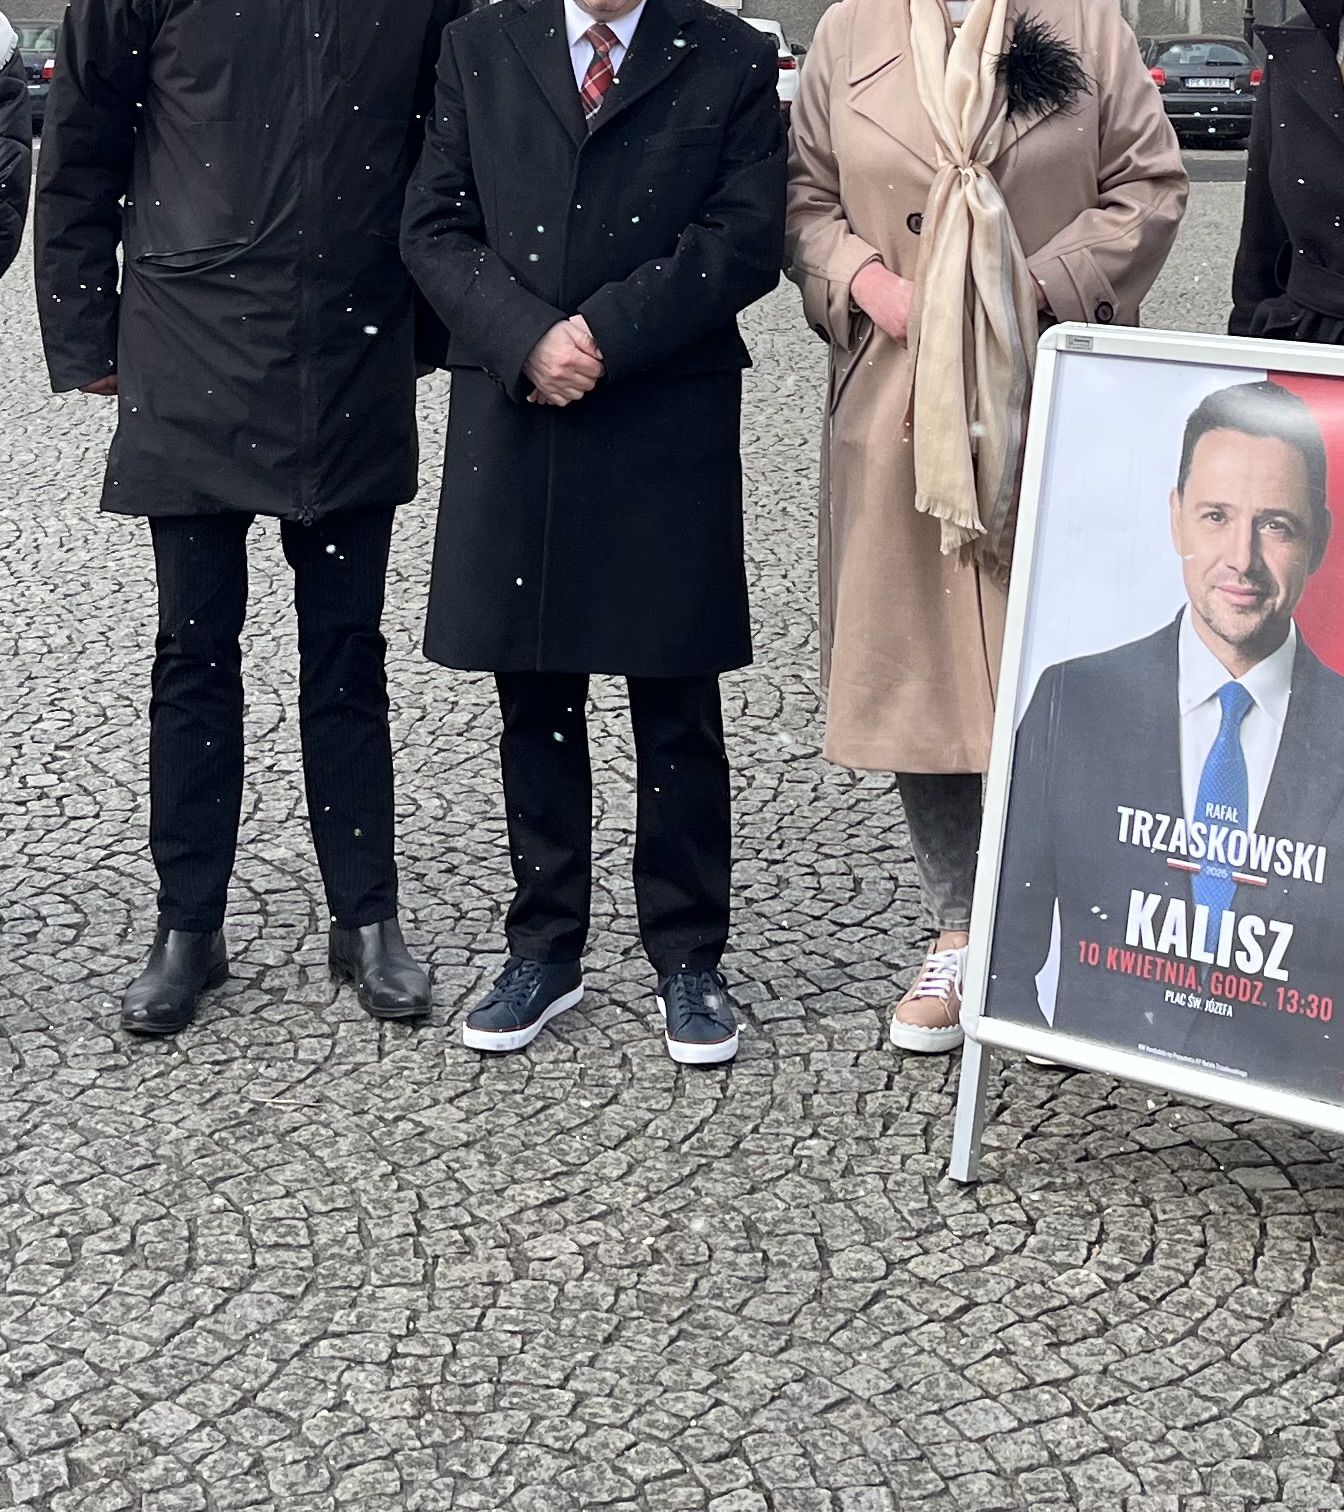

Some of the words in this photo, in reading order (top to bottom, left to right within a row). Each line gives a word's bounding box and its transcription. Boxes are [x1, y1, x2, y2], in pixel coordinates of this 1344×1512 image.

[1117, 805, 1327, 884] TRZASKOWSKI
[1205, 802, 1239, 824] RAFAŁ
[1125, 889, 1294, 982] KALISZ
[1078, 940, 1100, 966] 10
[1106, 946, 1203, 994] KWIETNIA,
[1210, 971, 1267, 1007] GODZ.
[1276, 986, 1333, 1022] 13:30
[1164, 989, 1187, 1007] PLAC
[1204, 997, 1233, 1018] JÓZEFA
